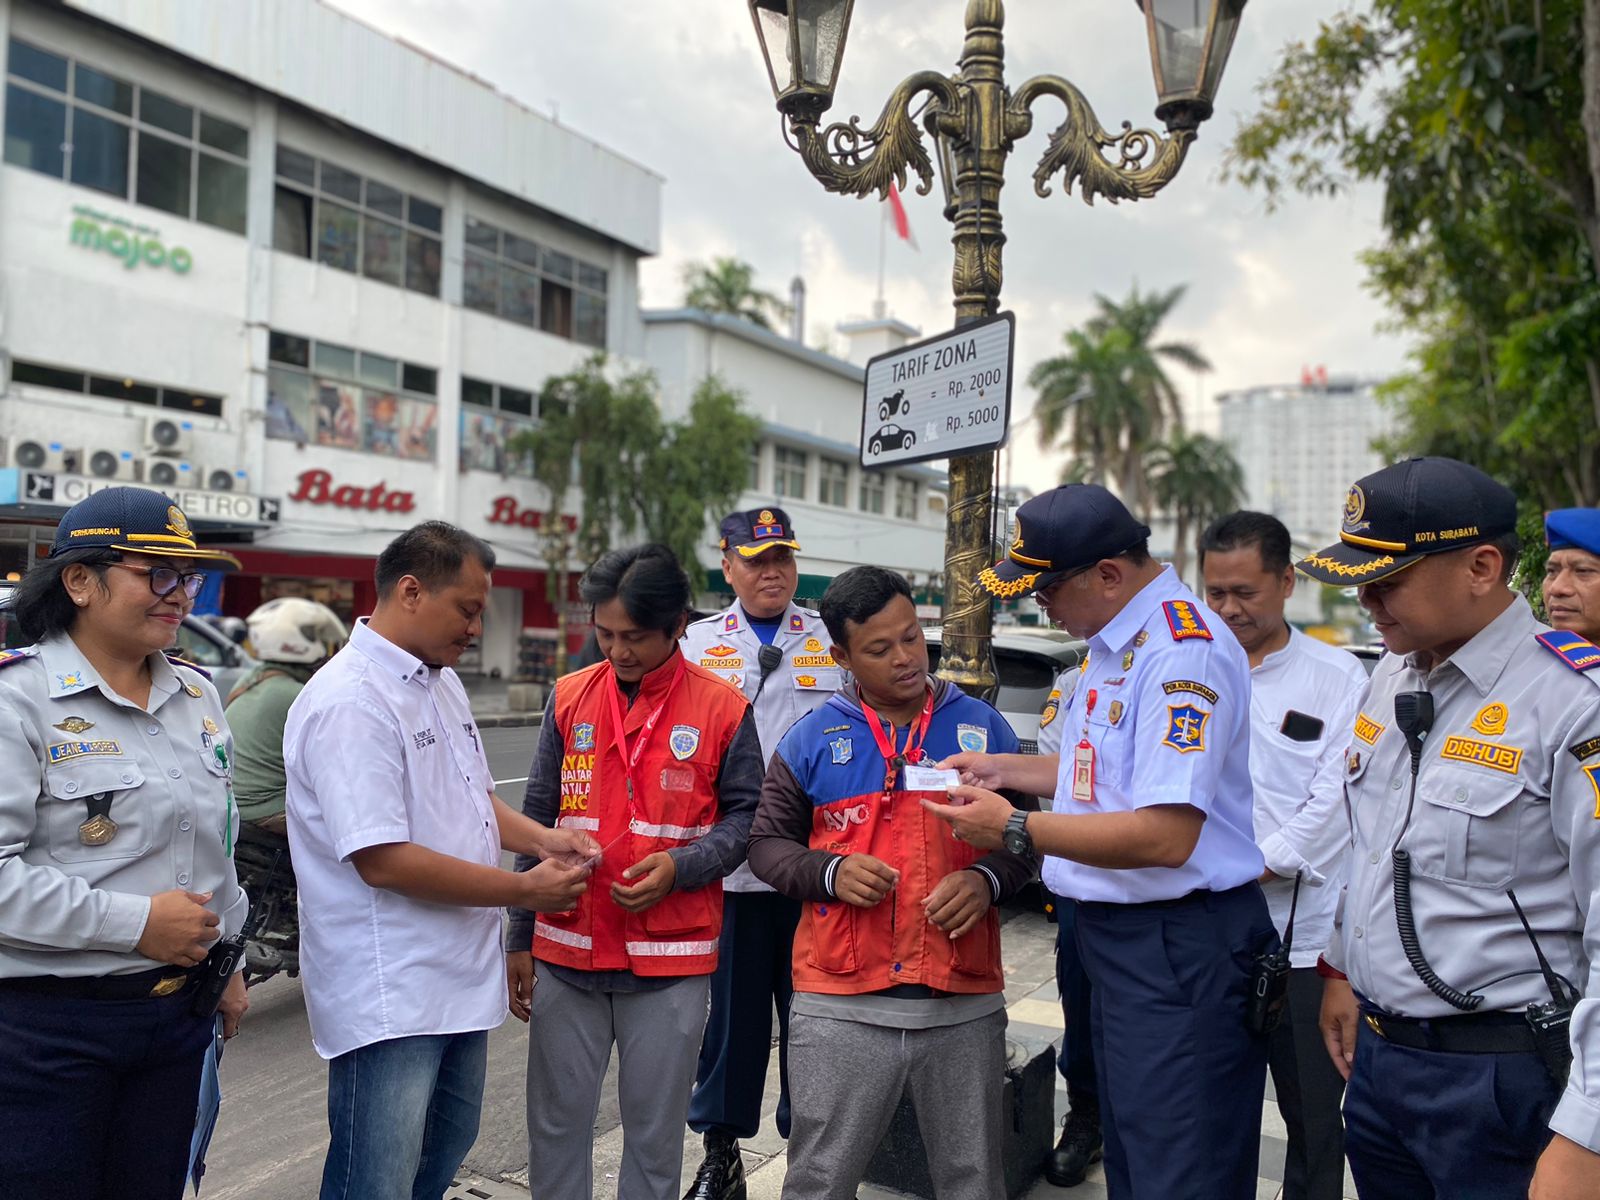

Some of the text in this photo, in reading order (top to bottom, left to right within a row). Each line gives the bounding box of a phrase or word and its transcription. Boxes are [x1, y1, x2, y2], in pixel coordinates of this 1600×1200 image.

[892, 338, 977, 383] TARIF ZONA
[948, 380, 966, 398] Rp.
[970, 368, 1001, 391] 2000
[946, 405, 999, 433] Rp. 5000
[288, 469, 415, 512] Bata
[486, 496, 577, 532] Baa
[70, 528, 120, 537] PERHUBUNGAN
[1415, 526, 1479, 543] KOTA SURABAYA
[702, 658, 739, 668] WIDODO
[795, 656, 833, 666] DISHUB
[56, 743, 84, 758] JEANE
[1447, 739, 1514, 767] DISHUB
